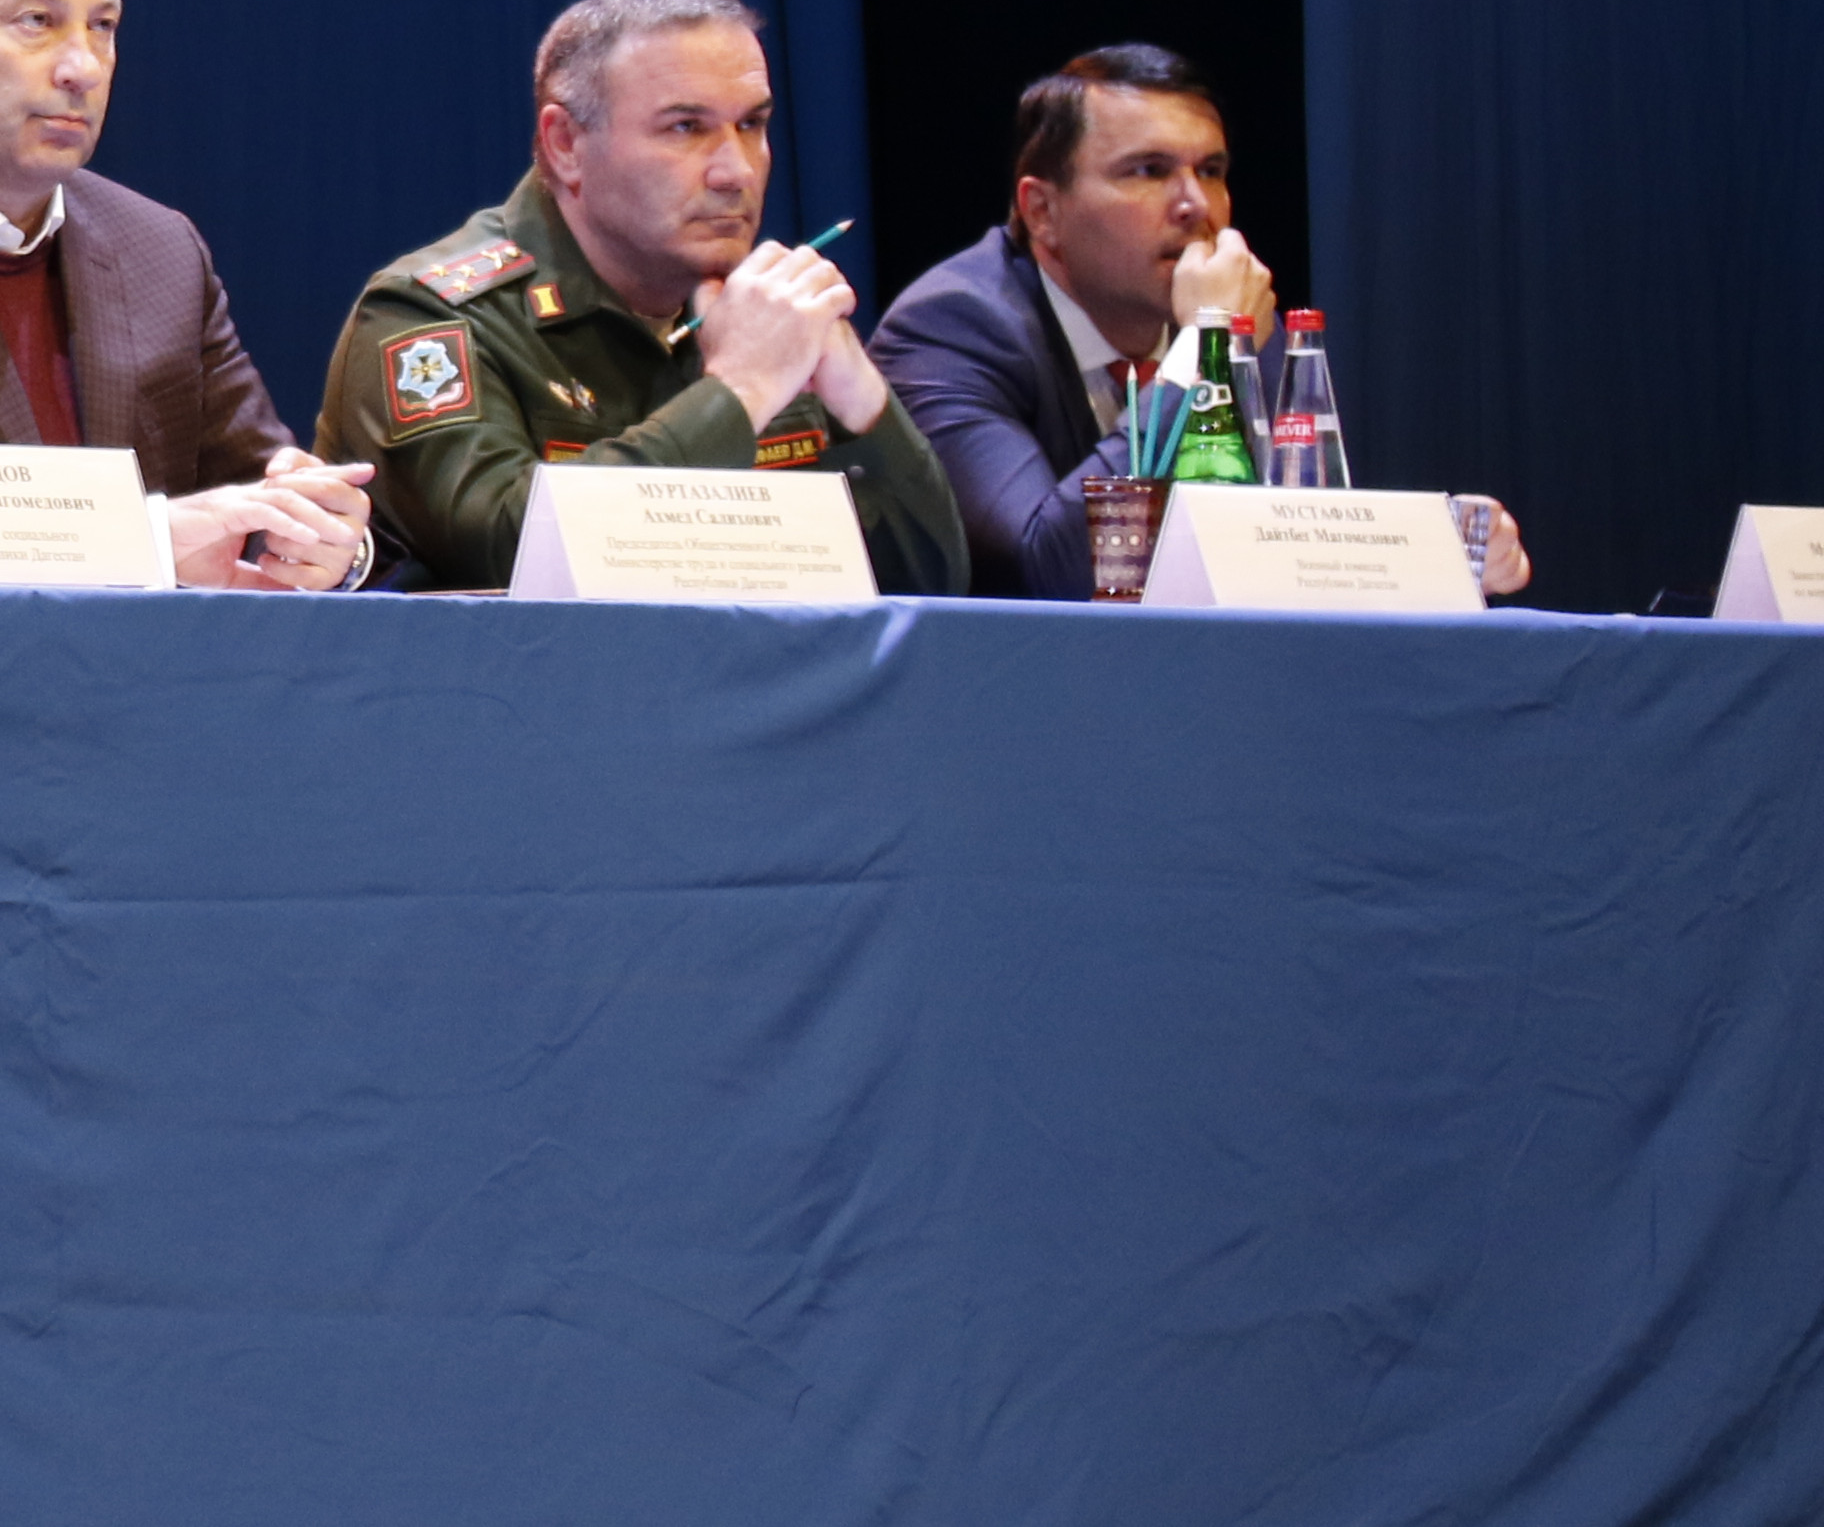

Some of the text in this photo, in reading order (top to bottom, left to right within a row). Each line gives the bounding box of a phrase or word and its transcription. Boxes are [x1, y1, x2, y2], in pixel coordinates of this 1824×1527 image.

[637, 482, 772, 502] МУРТАЗАЛИЕВ
[643, 508, 783, 527] Ахмед Салихович
[1270, 503, 1376, 522] МУСТАФАЕВ
[1, 529, 80, 543] социального
[31, 548, 86, 563] Дагестан
